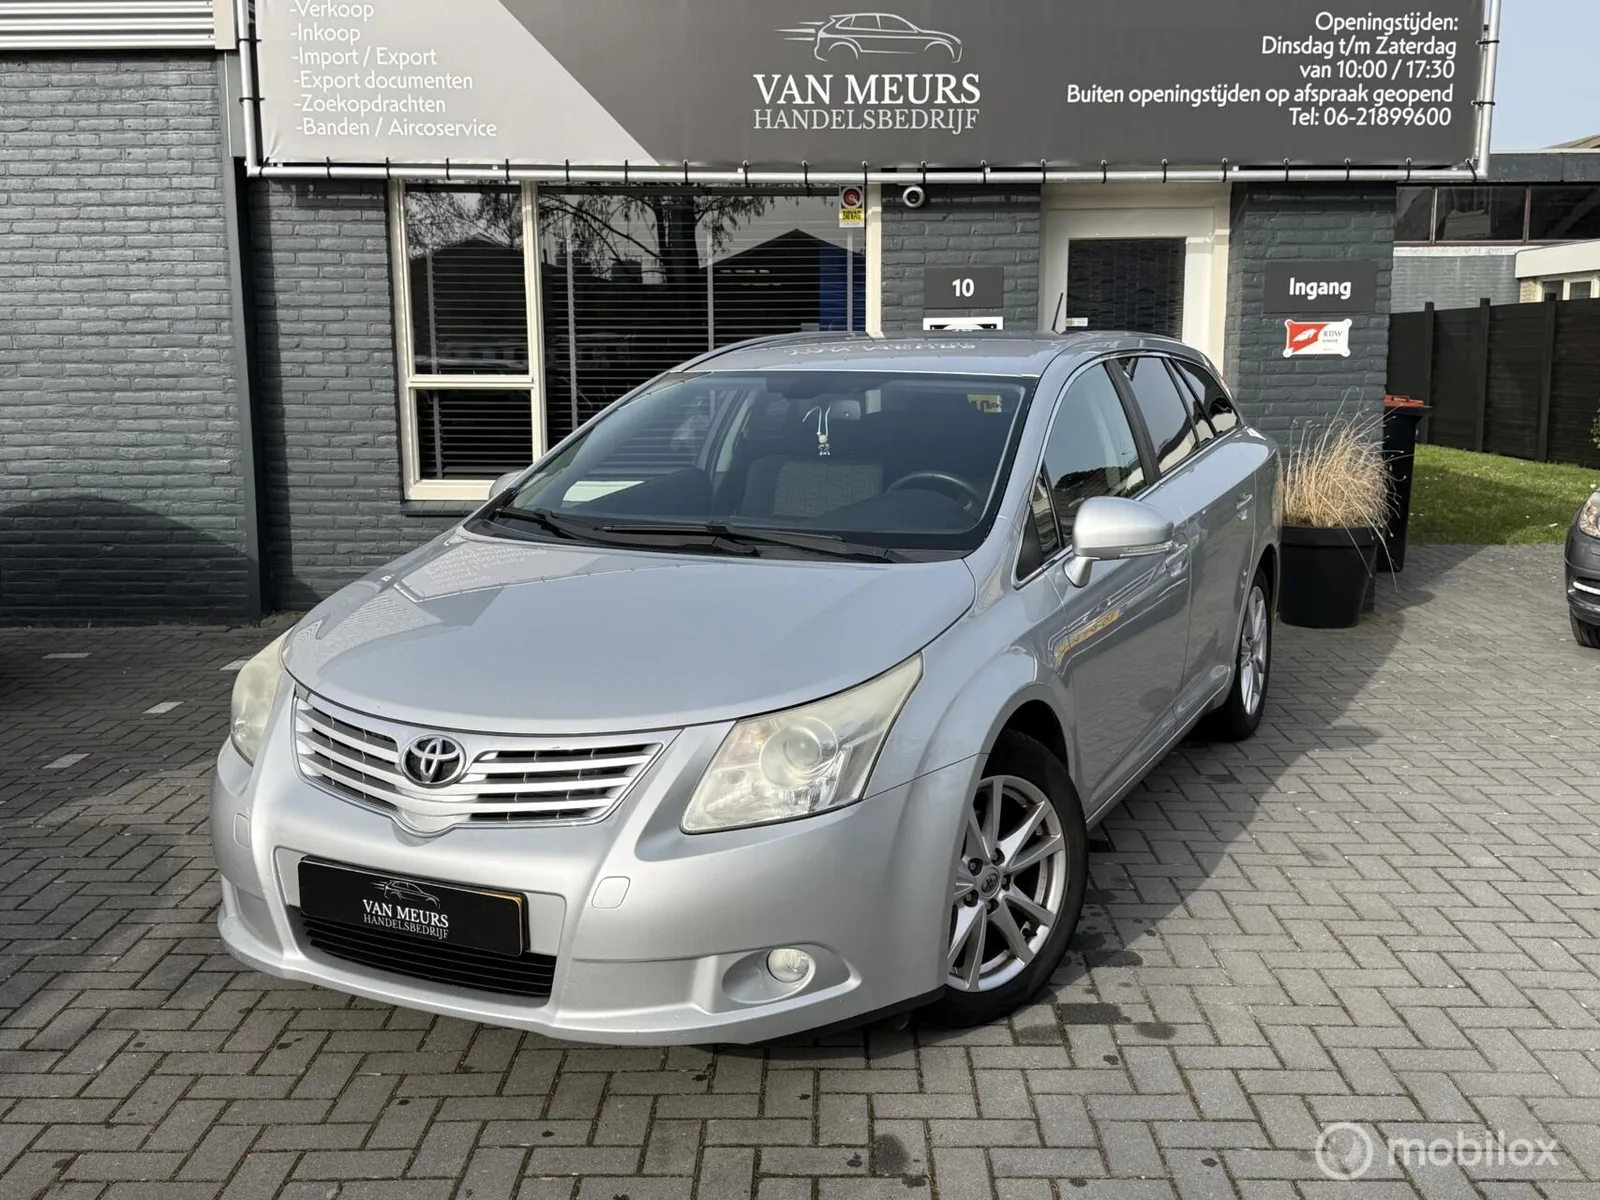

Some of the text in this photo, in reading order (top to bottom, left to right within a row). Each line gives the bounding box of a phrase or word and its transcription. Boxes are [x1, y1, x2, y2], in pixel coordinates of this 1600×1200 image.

[289, 0, 374, 23] -Verkoop
[290, 22, 361, 46] -Inkoop
[1315, 12, 1459, 35] Openingstijden:
[291, 45, 437, 68] -Import / Export
[1261, 35, 1457, 60] Dinsdag t/m Zaterdag
[293, 70, 473, 92] -Export documenten
[1299, 59, 1455, 81] van 10:00 / 17:30
[753, 73, 981, 104] VAN MEURS
[1067, 84, 1453, 108] Buiten openingstijden op afspraak geopend
[294, 94, 446, 115] -Zoekopdrachten
[296, 116, 498, 138] -Banden / Aircoservice
[753, 108, 980, 135] HANDELSBEDRIJF
[1289, 107, 1452, 126] Tel: 06-21899600
[952, 278, 975, 297] 10
[1289, 277, 1352, 300] Ingang
[362, 899, 449, 928] VAN MEURS
[363, 913, 449, 940] HANDELSBEDRIJF
